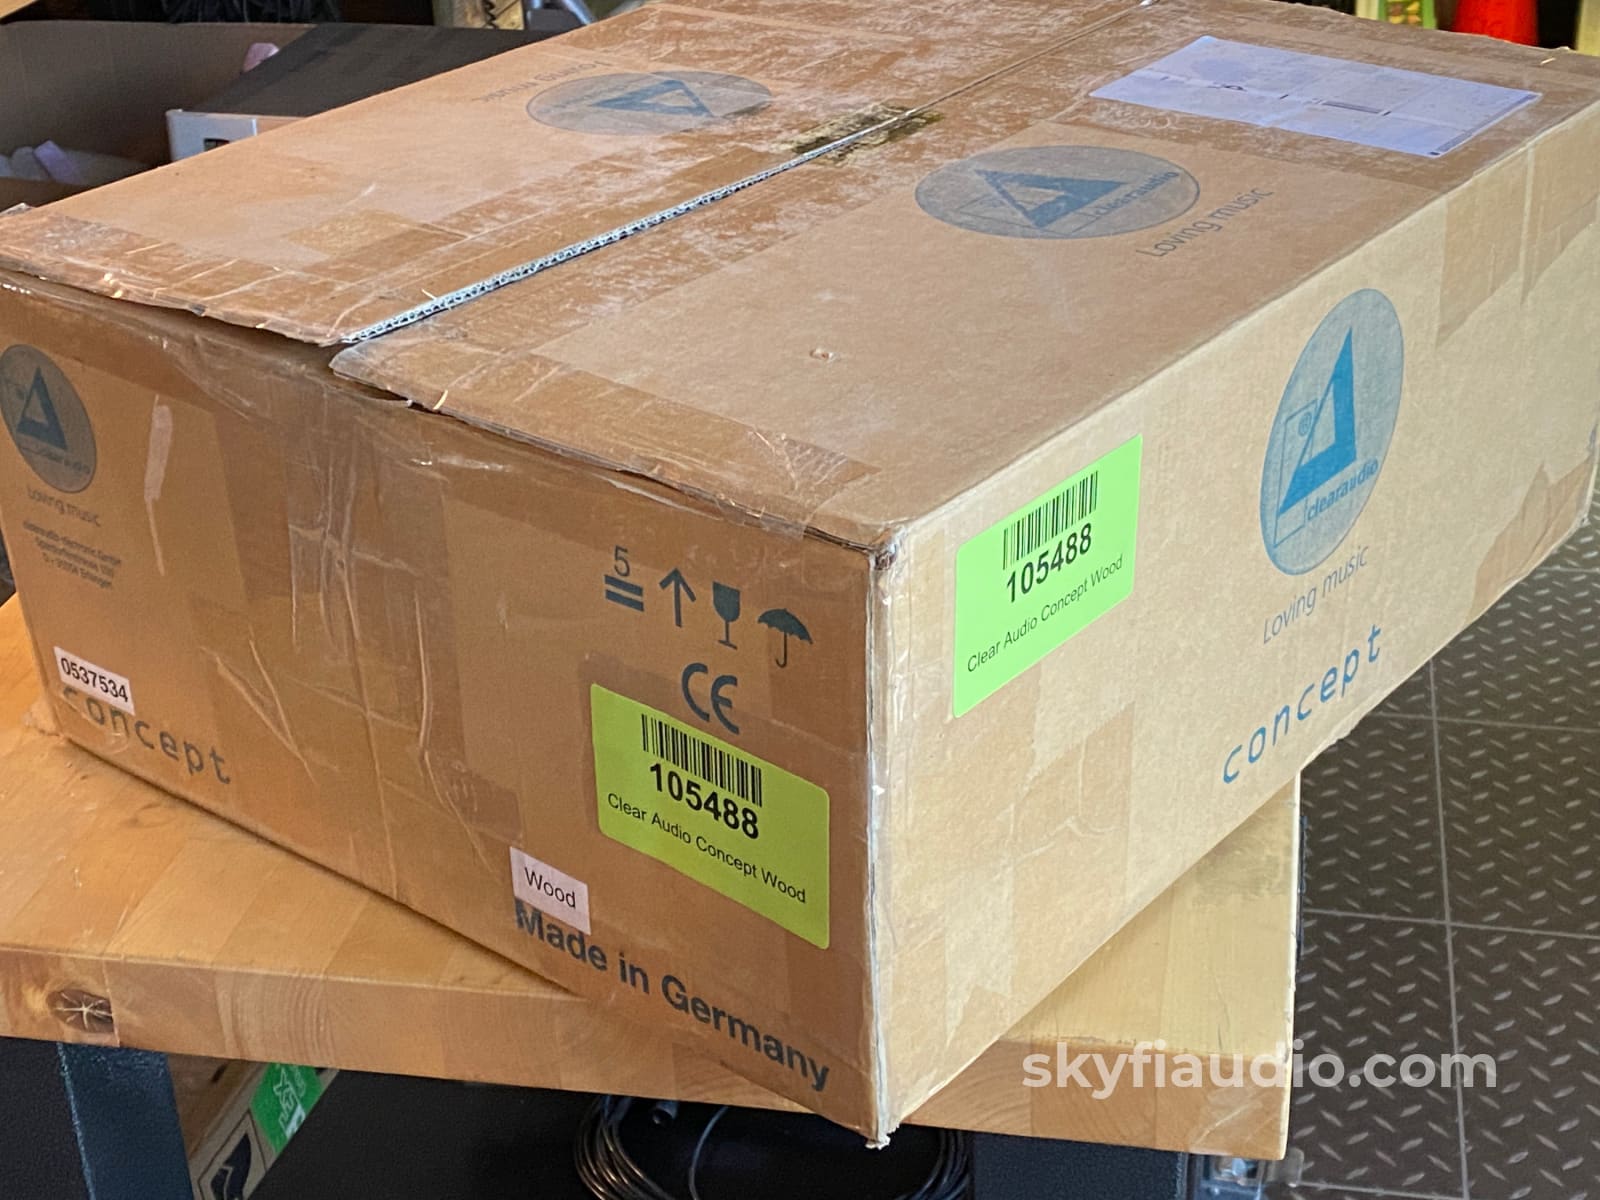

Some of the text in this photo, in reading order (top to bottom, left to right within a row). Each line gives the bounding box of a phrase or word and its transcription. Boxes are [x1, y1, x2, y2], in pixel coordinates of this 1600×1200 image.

[1135, 187, 1275, 257] Loving music
[1307, 459, 1379, 521] clearaudio
[613, 546, 631, 577] 5
[1006, 522, 1092, 603] 105488
[1263, 546, 1369, 644] Loving music
[967, 553, 1123, 673] Clear Audio Concept Wood
[61, 657, 129, 703] 0537534
[1222, 624, 1382, 785] concept
[650, 763, 759, 840] 105488
[524, 866, 577, 910] Wood
[608, 793, 807, 904] Clear Audio Concept Wood
[515, 897, 830, 1092] Made in Germany
